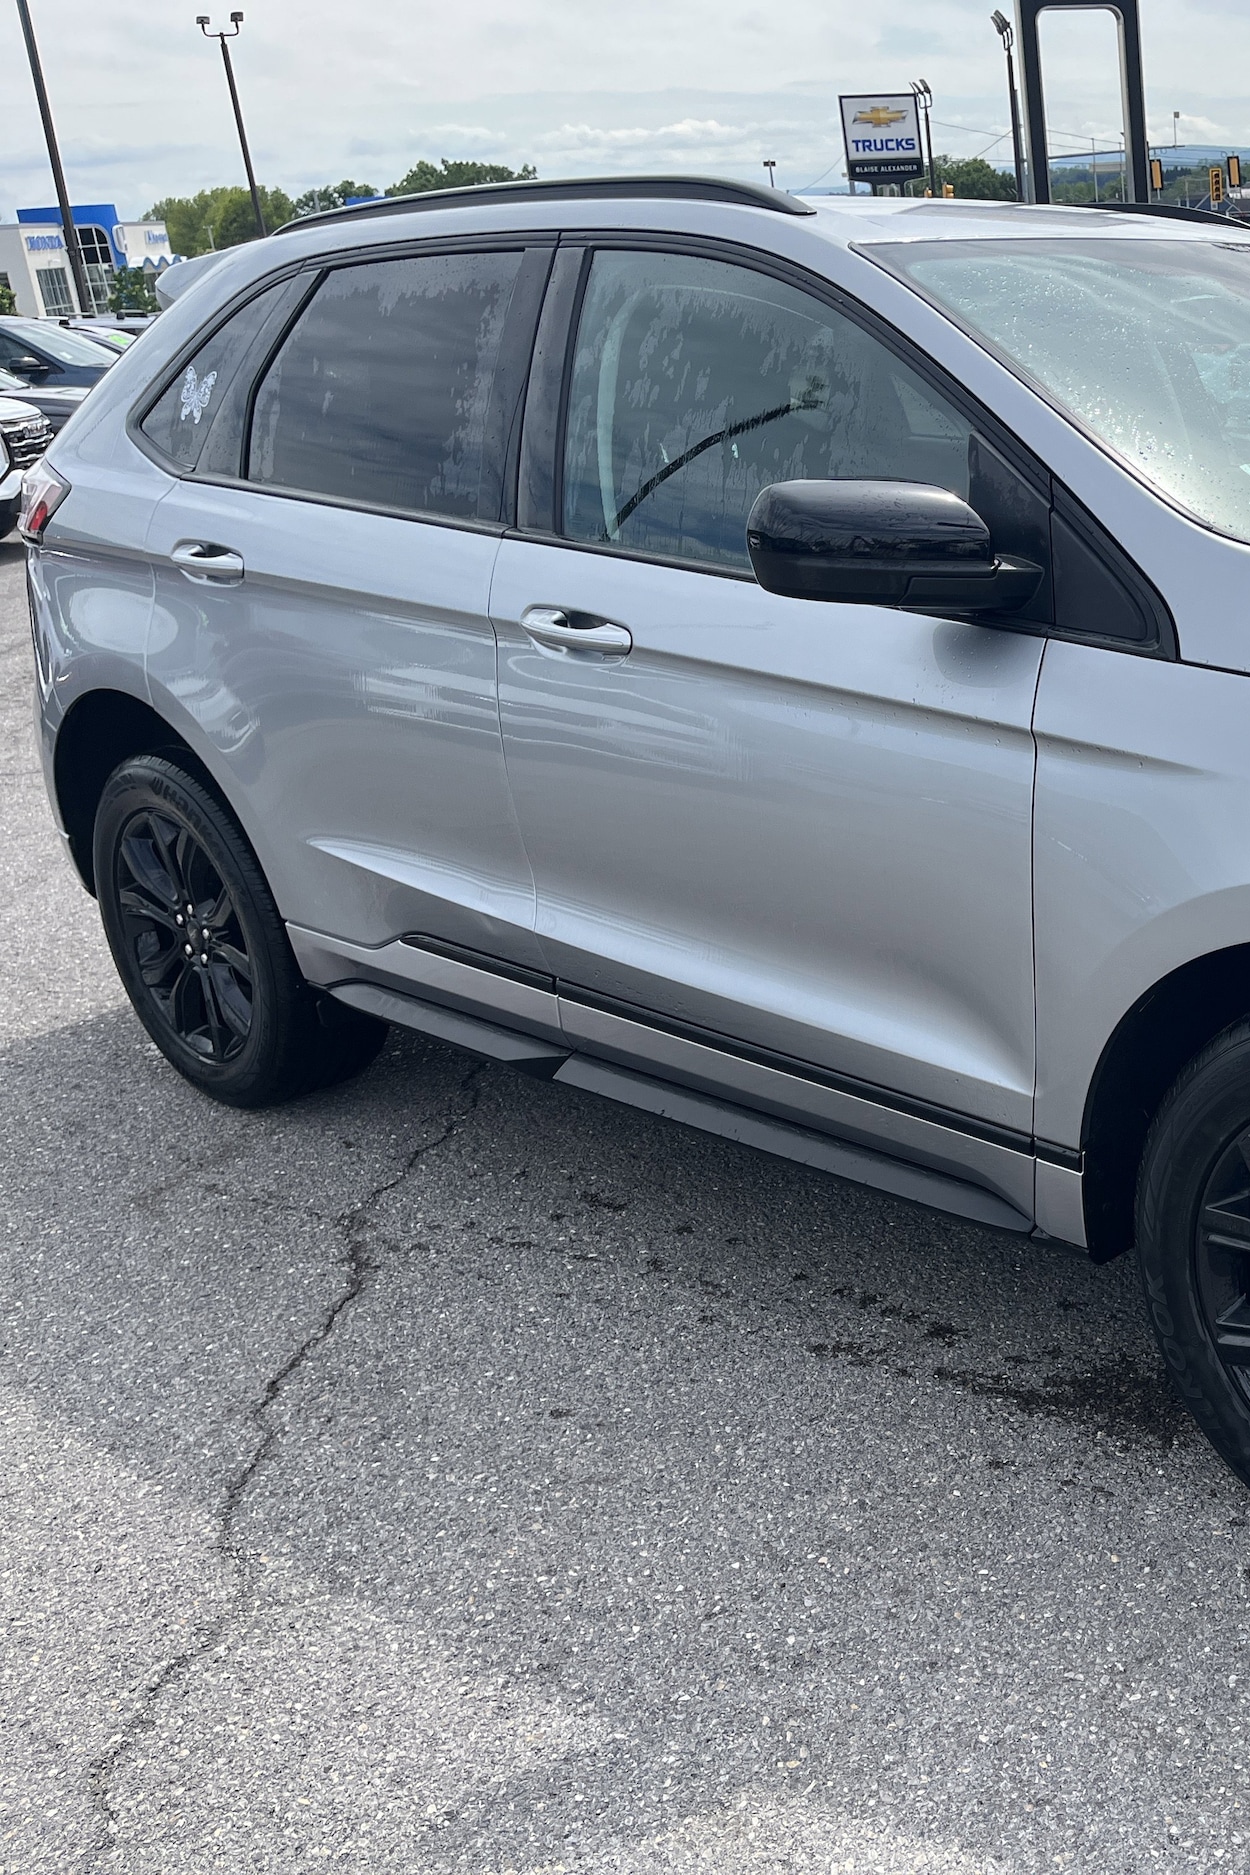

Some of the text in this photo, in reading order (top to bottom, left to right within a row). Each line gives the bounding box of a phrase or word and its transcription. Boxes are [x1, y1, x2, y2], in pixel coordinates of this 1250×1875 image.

[852, 138, 916, 152] TRUCKS
[855, 164, 918, 173] BLAISE ALEXANDER
[26, 235, 64, 250] HONDA
